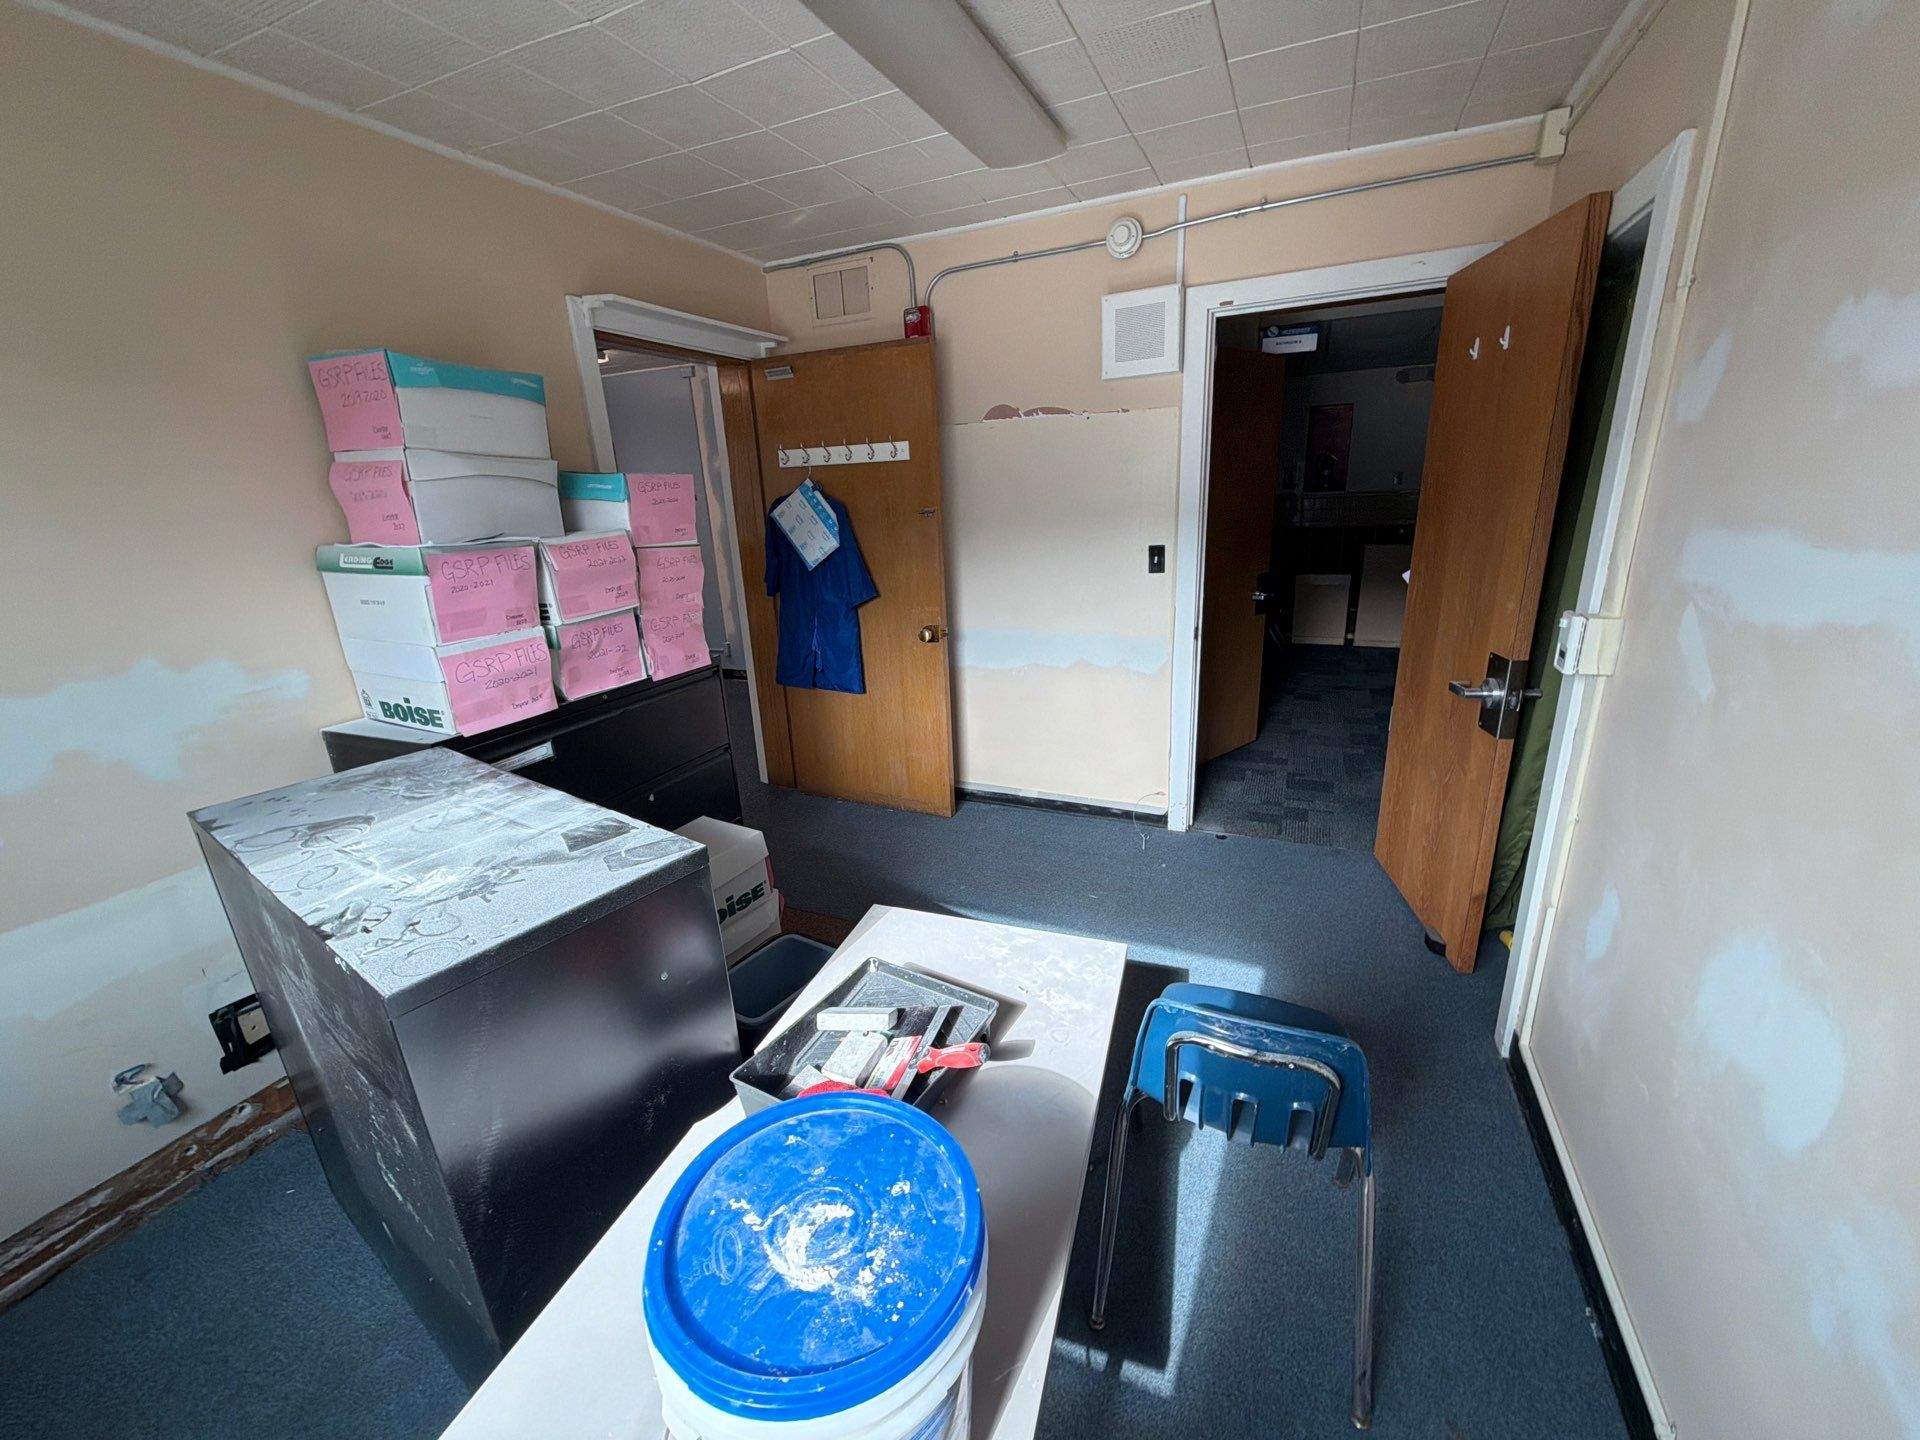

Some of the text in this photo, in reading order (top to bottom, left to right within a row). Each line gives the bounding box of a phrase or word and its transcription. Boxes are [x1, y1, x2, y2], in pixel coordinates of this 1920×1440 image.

[596, 540, 620, 552] FILES
[441, 552, 532, 583] GSRP FILES
[602, 622, 624, 638] FILES
[455, 643, 548, 686] GSRP FILES
[378, 696, 445, 729] BOISE
